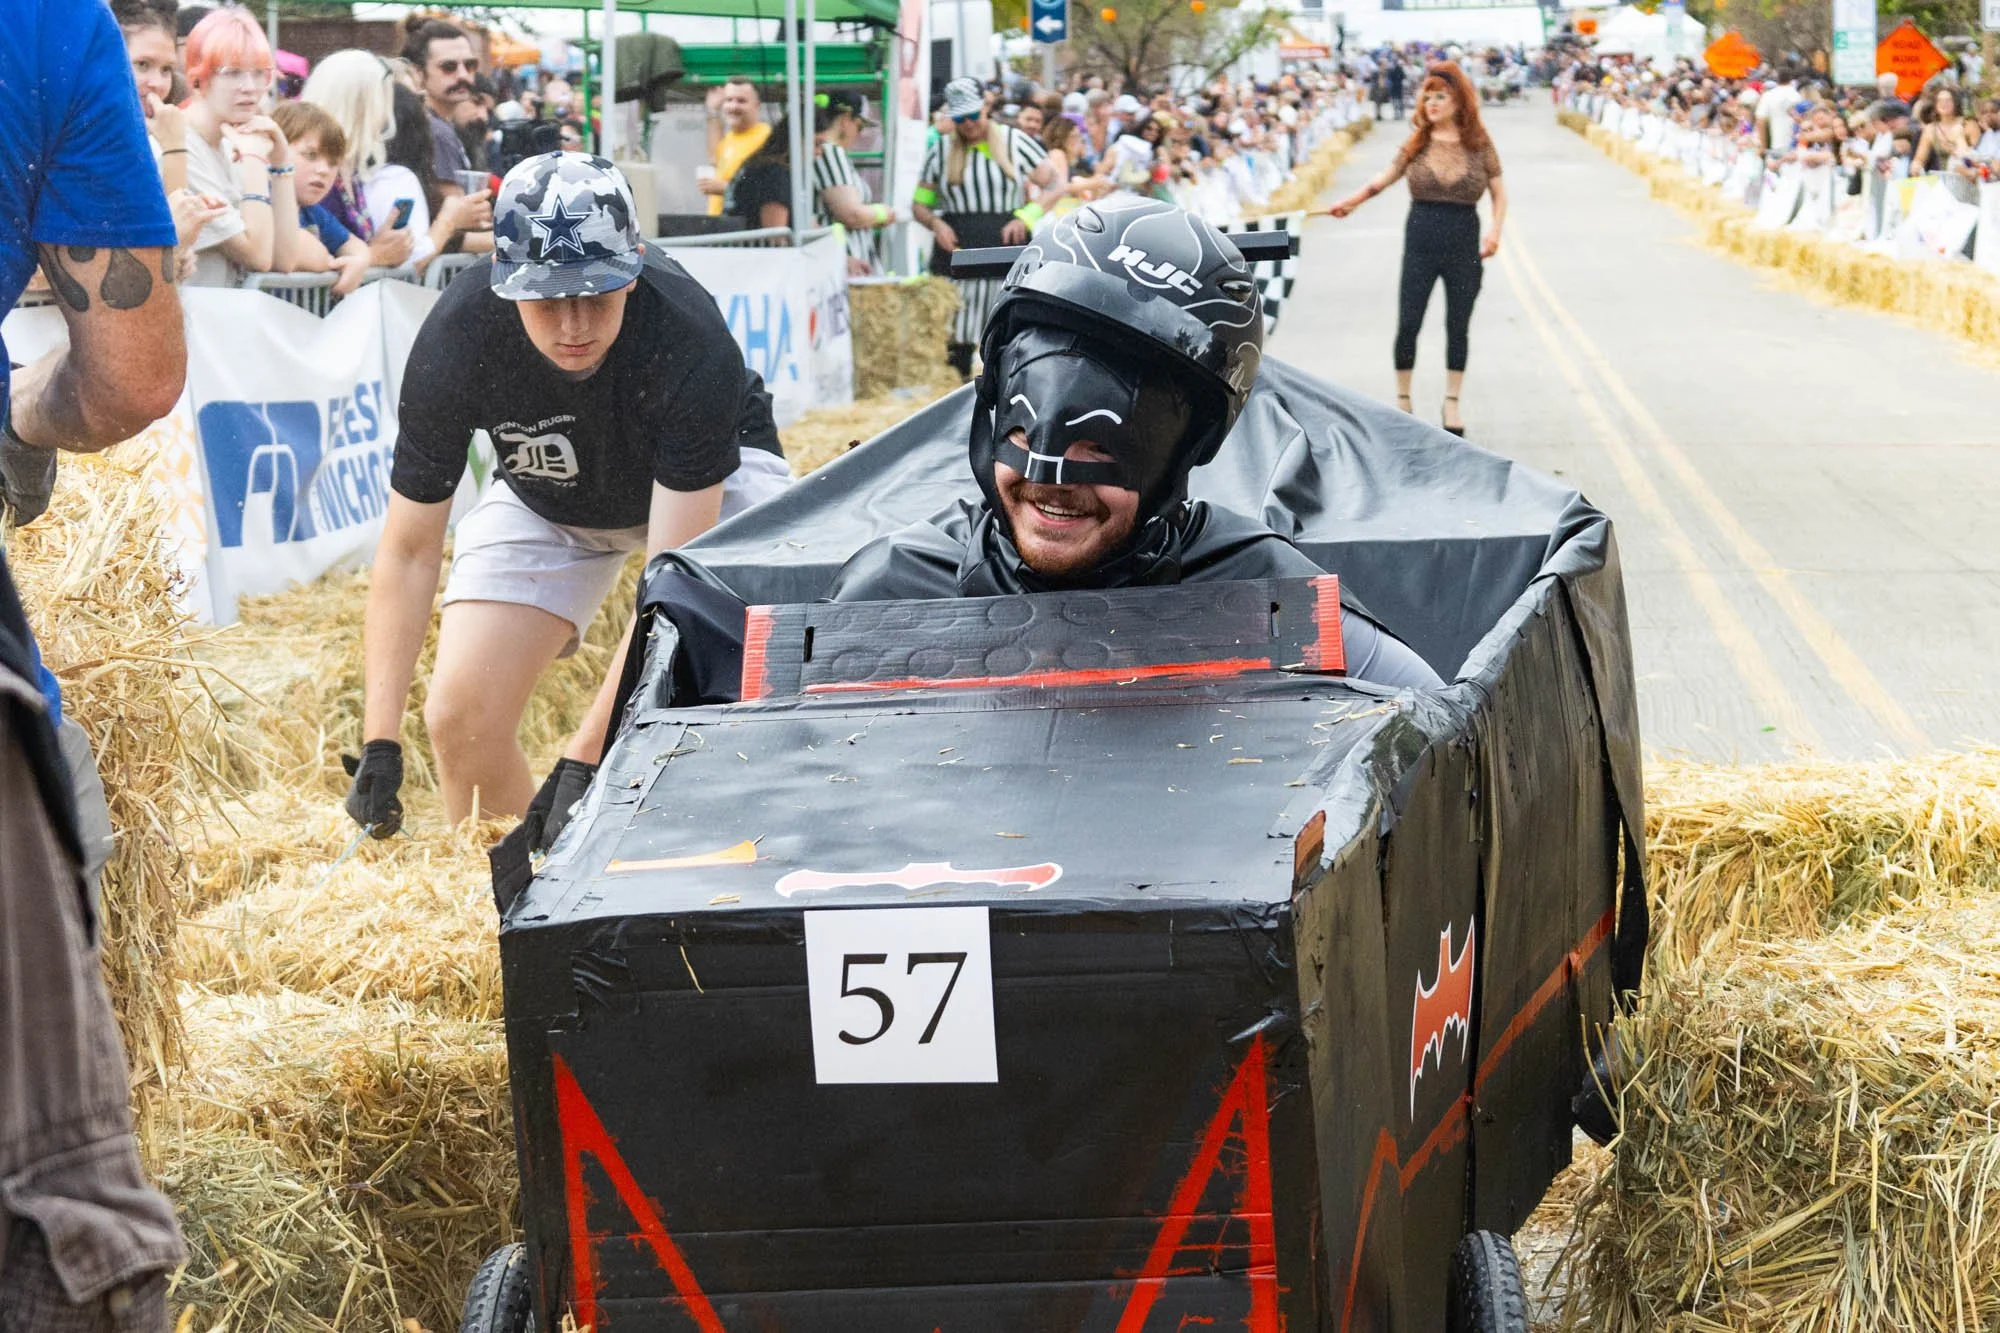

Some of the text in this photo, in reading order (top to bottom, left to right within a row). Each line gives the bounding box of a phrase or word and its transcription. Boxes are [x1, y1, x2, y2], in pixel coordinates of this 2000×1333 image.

[1107, 244, 1203, 296] HJC
[492, 414, 577, 436] DENTON RUGBY
[838, 951, 968, 1045] 57
